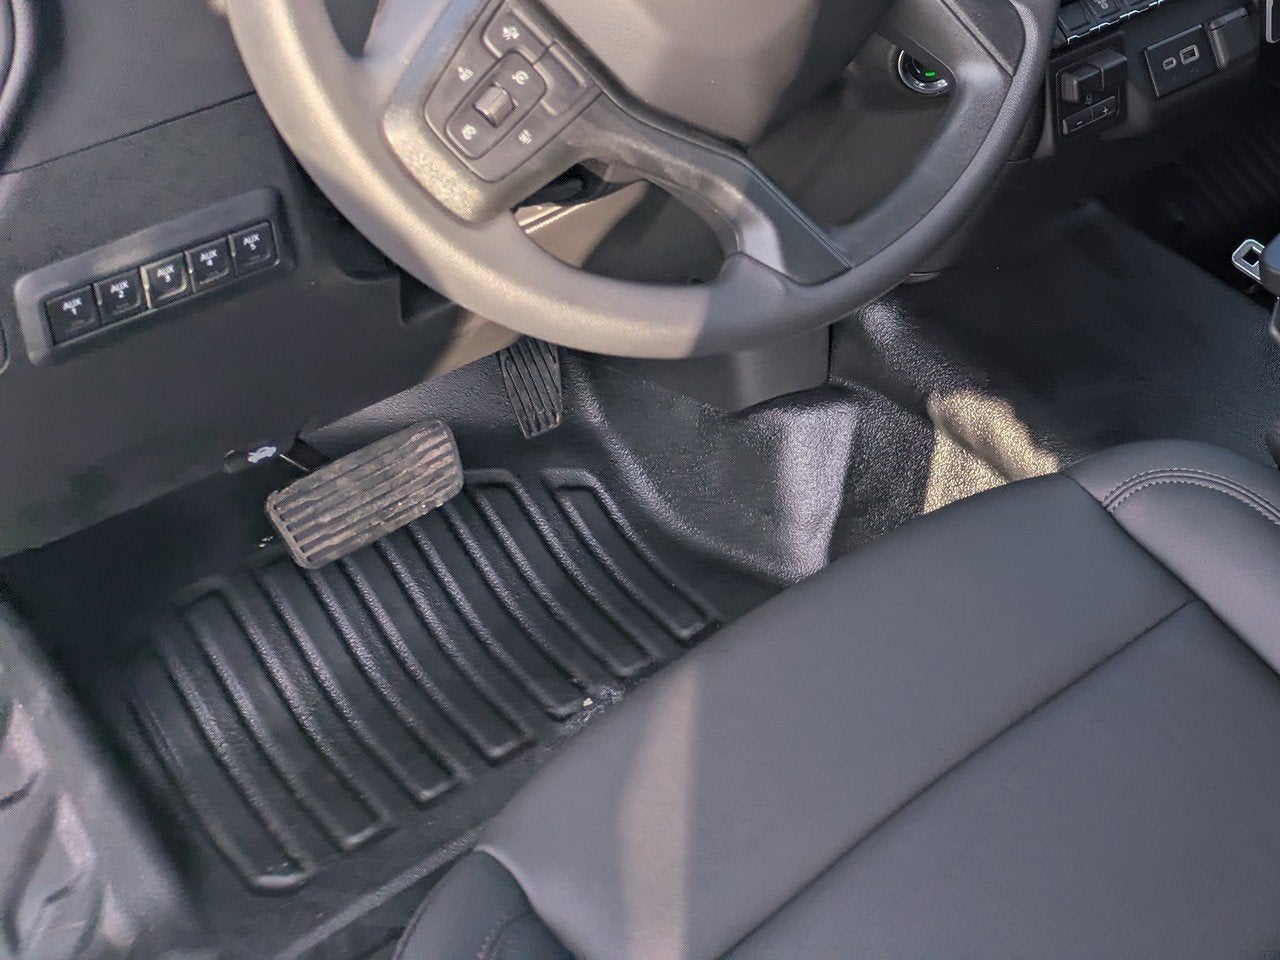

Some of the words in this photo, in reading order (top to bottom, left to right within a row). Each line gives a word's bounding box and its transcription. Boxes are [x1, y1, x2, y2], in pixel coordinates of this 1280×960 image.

[243, 233, 260, 247] AUX
[200, 249, 218, 262] AUX
[156, 265, 175, 279] AUX
[110, 280, 130, 295] AUX
[62, 297, 82, 312] AUX
